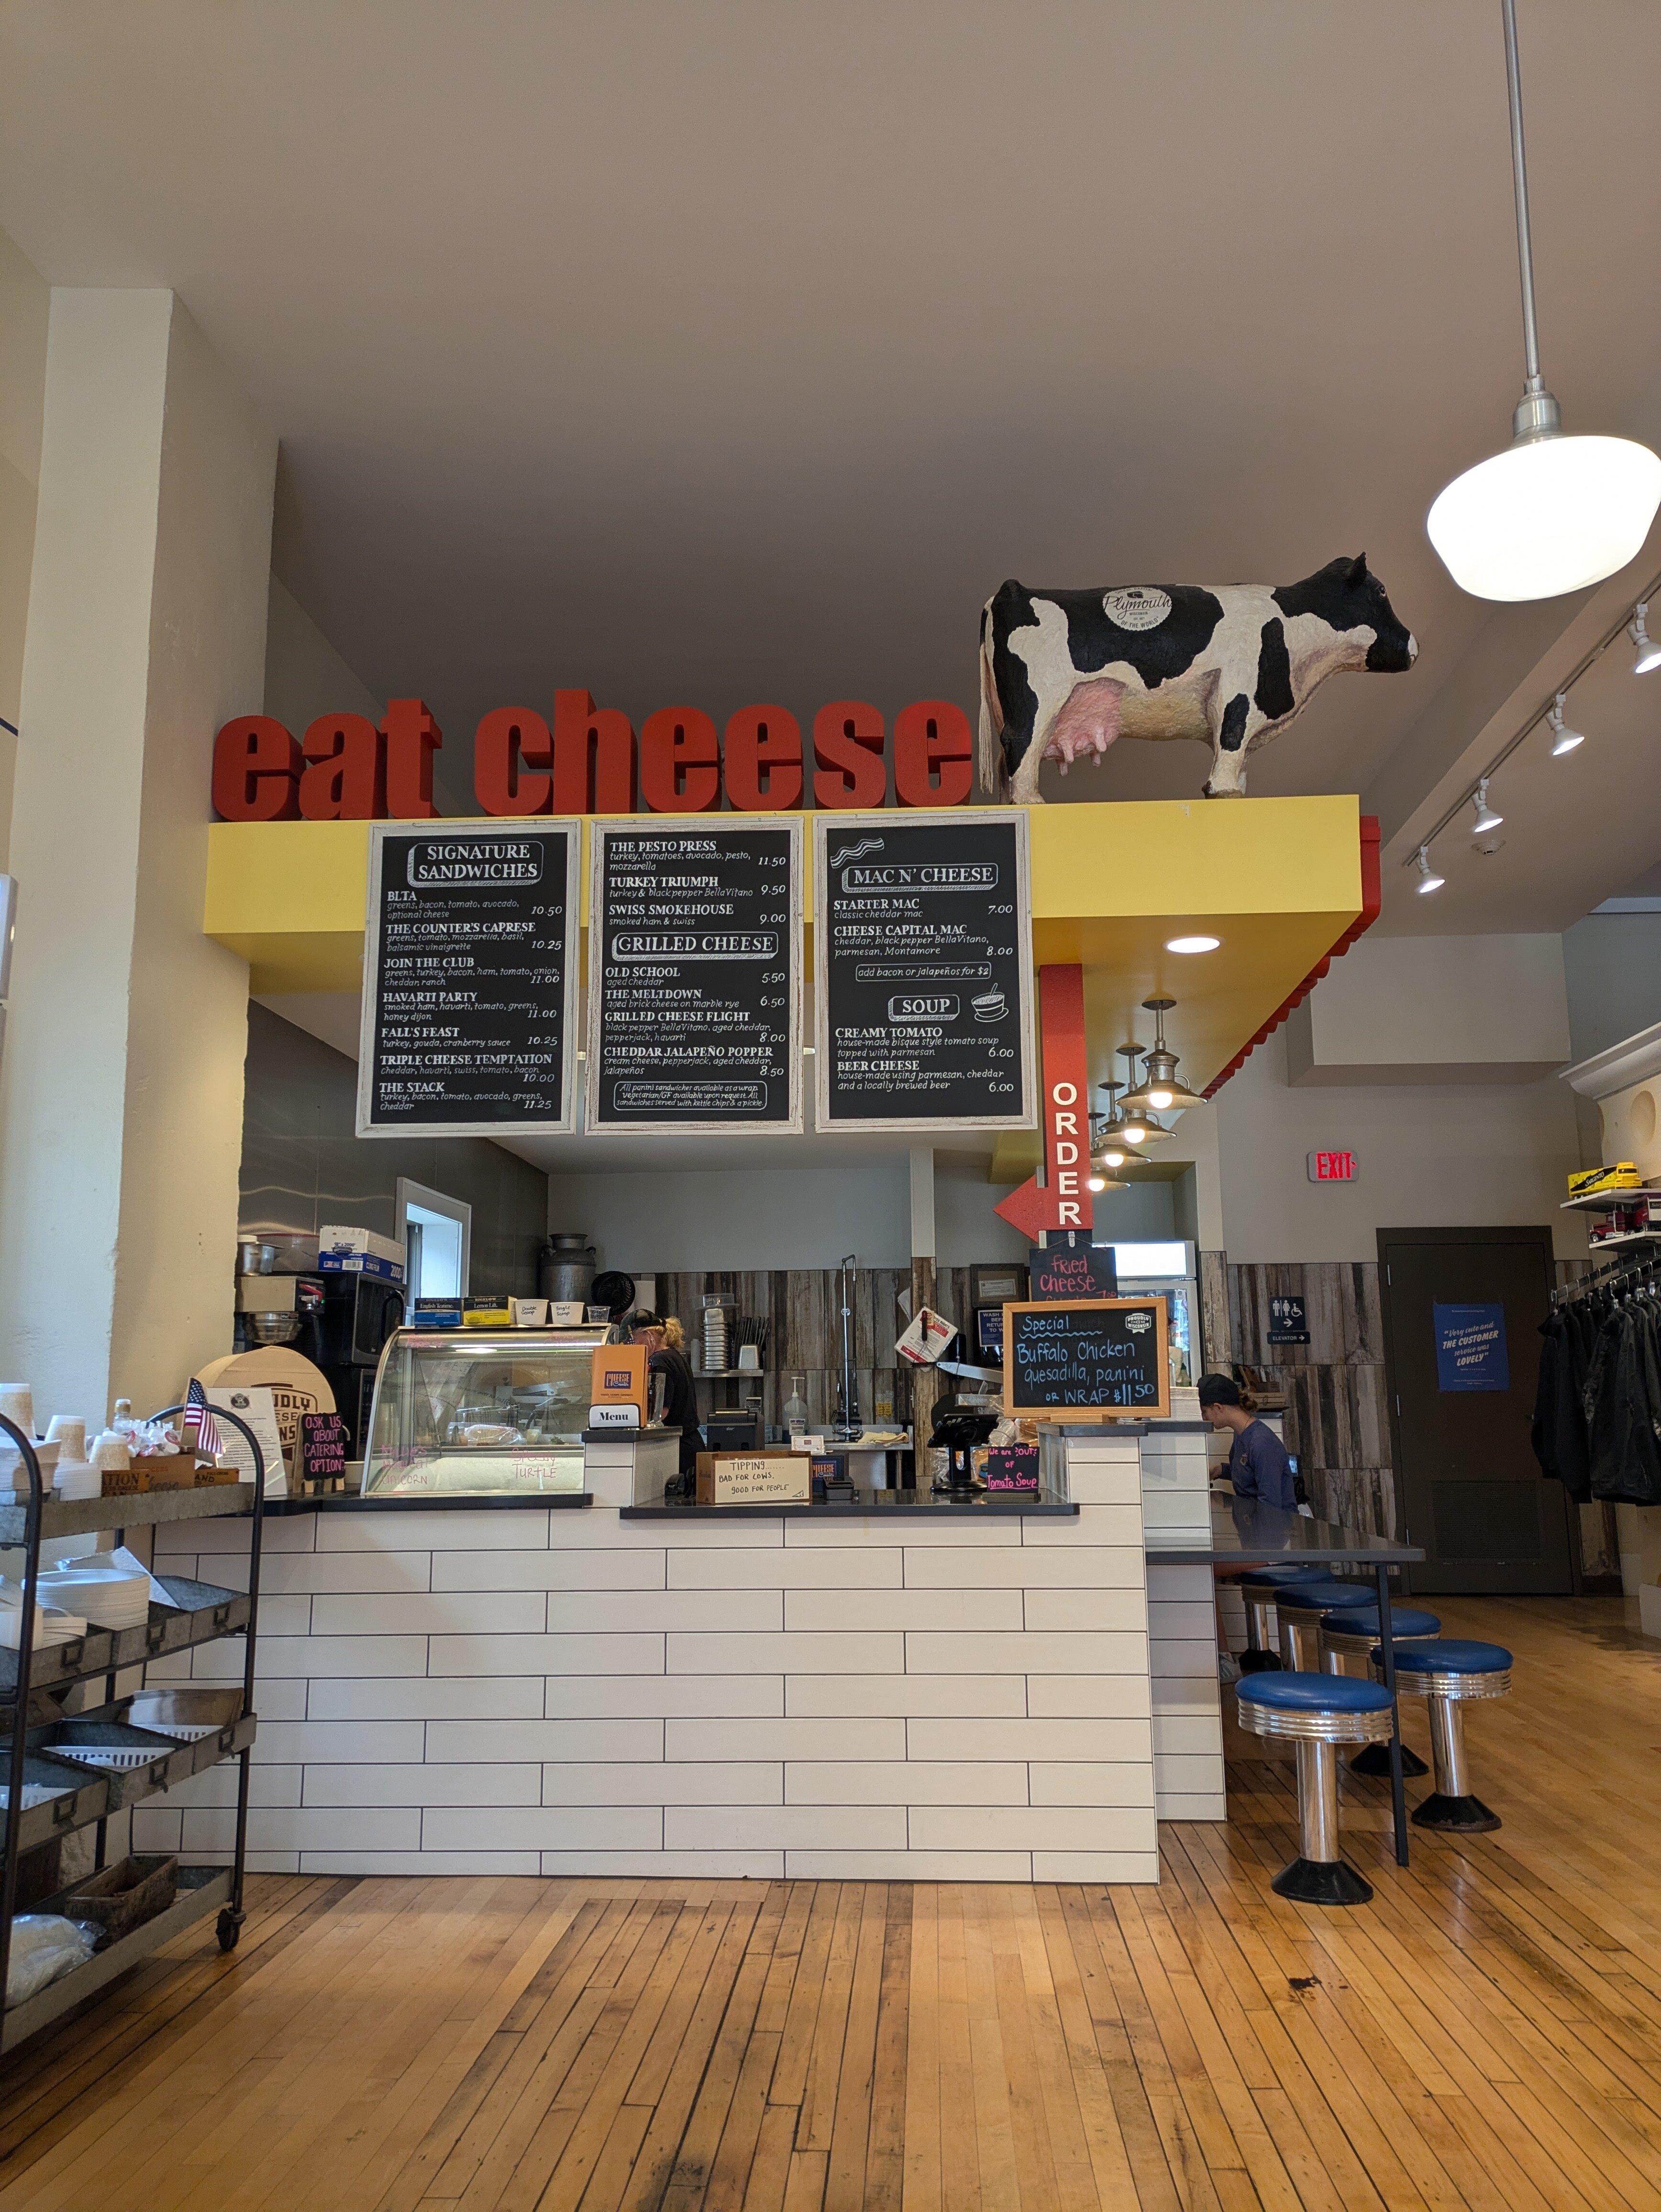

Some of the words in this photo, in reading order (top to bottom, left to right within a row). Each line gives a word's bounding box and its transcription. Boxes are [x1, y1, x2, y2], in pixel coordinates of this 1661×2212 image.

[1103, 595, 1172, 619] Plymouth
[212, 698, 442, 821] eat
[475, 689, 972, 816] cheese
[610, 842, 635, 852] THE
[639, 841, 676, 852] PESTO
[679, 841, 716, 851] PRESS
[428, 845, 530, 860] SIGNATURE
[759, 857, 786, 866] 11.50
[419, 863, 537, 879] SANDWICHES
[854, 870, 894, 883] MAC
[899, 869, 916, 883] N'
[921, 868, 993, 882] CHEESE
[609, 877, 658, 887] TURKEY
[660, 876, 718, 887] TRIUMPH
[388, 891, 417, 901] BLTA
[609, 905, 644, 915] SWISS
[649, 904, 733, 915] SMOKEHOUSE
[834, 899, 889, 910] STARTER
[893, 899, 919, 908] MAC
[388, 910, 422, 918] optional
[423, 910, 449, 918] cheese
[532, 907, 562, 916] 10.50
[386, 924, 410, 933] THE
[413, 923, 479, 933] COUNTER'S
[483, 922, 535, 932] CAPRESE
[834, 926, 882, 936] CHEESE
[886, 925, 937, 935] CAPITAL
[940, 925, 966, 934] MAC
[532, 940, 562, 950] 10.25
[619, 937, 696, 951] GRILLED
[702, 937, 773, 951] CHEESE
[384, 958, 412, 968] JOIN
[416, 958, 440, 967] THE
[443, 958, 474, 967] CLUB
[606, 968, 629, 977] OLD
[632, 967, 680, 977] SCHOOL
[859, 968, 875, 976] add
[877, 968, 903, 976] bacon
[916, 967, 960, 977] jalapeños
[961, 967, 975, 976] for
[978, 966, 988, 975] $2
[383, 993, 436, 1002] HAVARTI
[439, 992, 477, 1001] PARTY
[605, 990, 630, 999] THE
[631, 989, 702, 999] MELTDOWN
[903, 999, 950, 1013] SOUP
[605, 1012, 654, 1021] GRILLED
[658, 1012, 703, 1021] CHEESE
[706, 1012, 750, 1021] FLIGHT
[382, 1027, 420, 1037] FALL'S
[422, 1027, 459, 1037] FEAST
[836, 1028, 887, 1038] CREAMY
[889, 1028, 942, 1037] TOMATO
[604, 1047, 663, 1056] CHEDDAR
[664, 1046, 724, 1056] JALAPEÑO
[728, 1047, 773, 1056] POPPER
[989, 1047, 1013, 1057] 6.00
[380, 1055, 422, 1064] TRIPLE
[425, 1055, 472, 1064] CHEESE
[475, 1054, 552, 1064] TEMPTATION
[837, 1062, 869, 1071] BEER
[871, 1061, 919, 1071] CHEESE
[379, 1083, 404, 1092] THE
[407, 1083, 444, 1092] STACK
[712, 1099, 730, 1108] chips
[1053, 1083, 1082, 1225] ORDER
[1317, 1152, 1351, 1179] EXIT
[1585, 1171, 1605, 1187] SARGENTO
[1023, 1315, 1069, 1334] Special
[1465, 1325, 1479, 1334] cute
[1480, 1321, 1495, 1330] and
[1443, 1339, 1457, 1349] THE
[1458, 1330, 1499, 1346] CUSTOMER
[1017, 1341, 1068, 1364] Buffalo
[1077, 1339, 1135, 1361] Chicken
[1454, 1347, 1476, 1357] service
[607, 1373, 630, 1386] CHEESE
[1024, 1361, 1089, 1390] quesadilla,
[1096, 1365, 1144, 1387] panini
[1064, 1388, 1109, 1405] WRAP
[330, 1416, 342, 1428] US
[599, 1412, 629, 1421] Menu
[304, 1442, 344, 1457] CATERING
[987, 1474, 1014, 1488] Tomato
[1016, 1472, 1037, 1488] Soup
